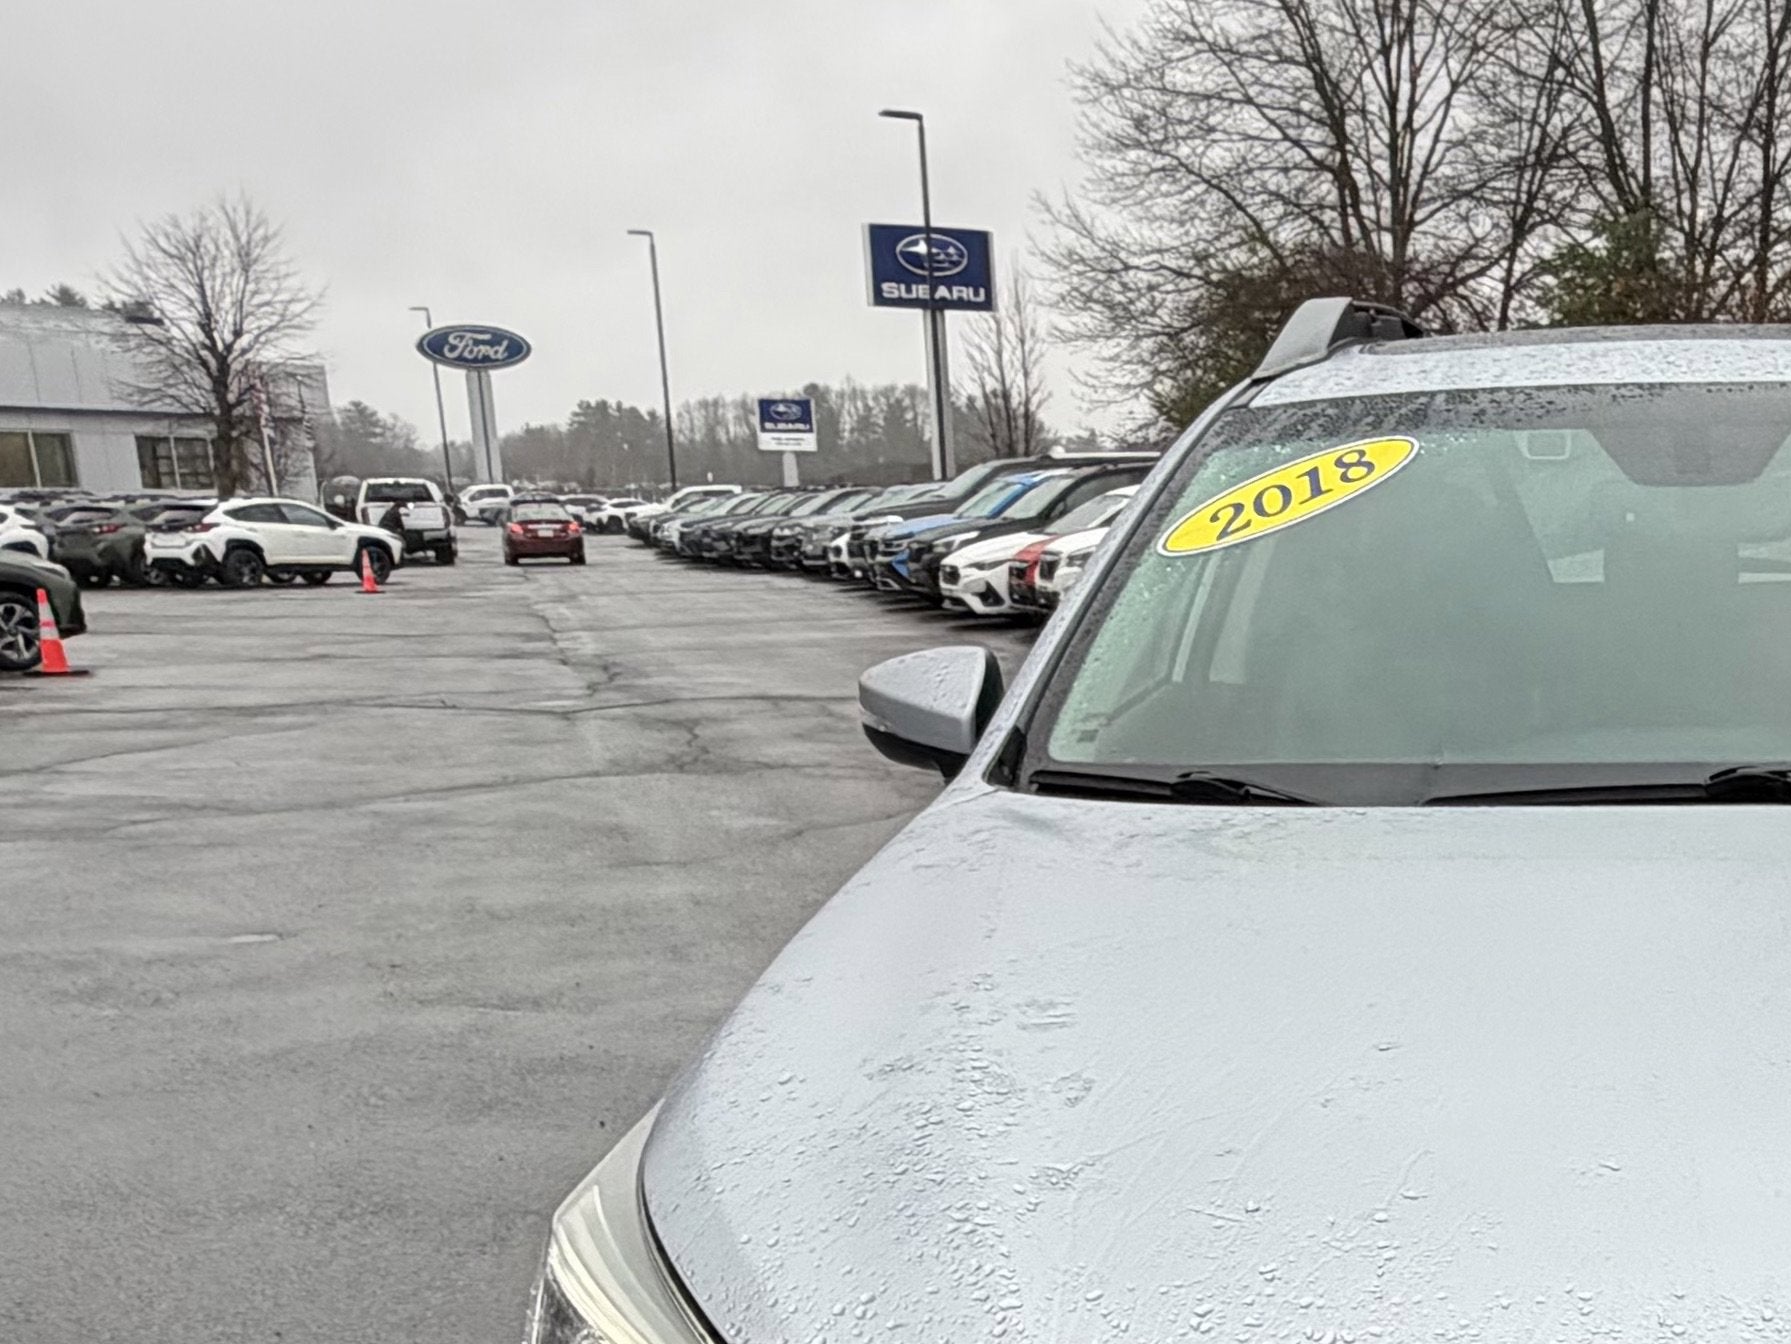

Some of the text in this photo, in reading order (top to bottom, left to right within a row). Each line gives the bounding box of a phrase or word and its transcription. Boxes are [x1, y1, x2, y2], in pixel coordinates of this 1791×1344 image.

[881, 281, 985, 302] SUBARU
[443, 331, 509, 359] Ford
[1209, 448, 1376, 542] 2018
